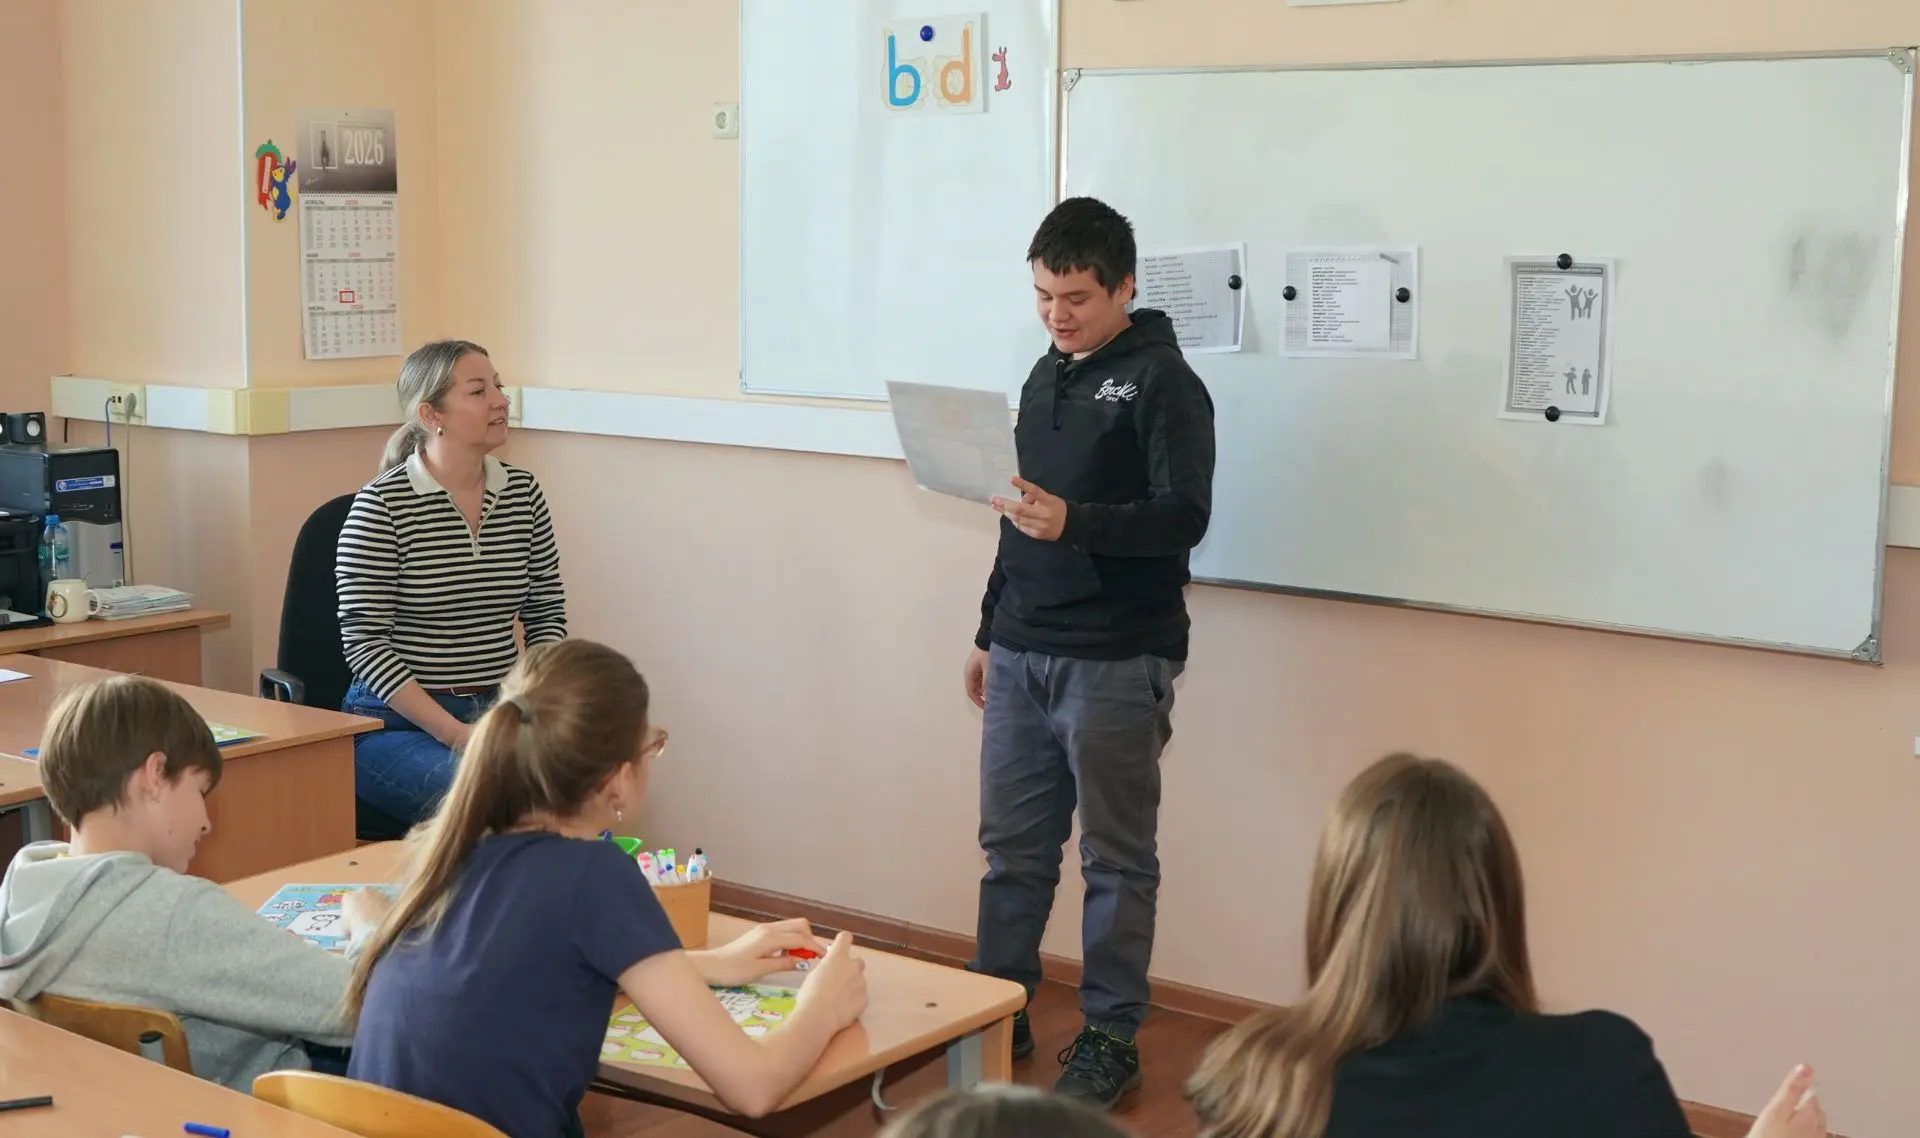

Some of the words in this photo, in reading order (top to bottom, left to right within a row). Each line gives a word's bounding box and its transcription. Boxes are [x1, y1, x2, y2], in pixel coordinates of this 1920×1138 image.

[888, 34, 921, 106] b
[940, 28, 971, 104] d
[344, 129, 384, 165] 2026
